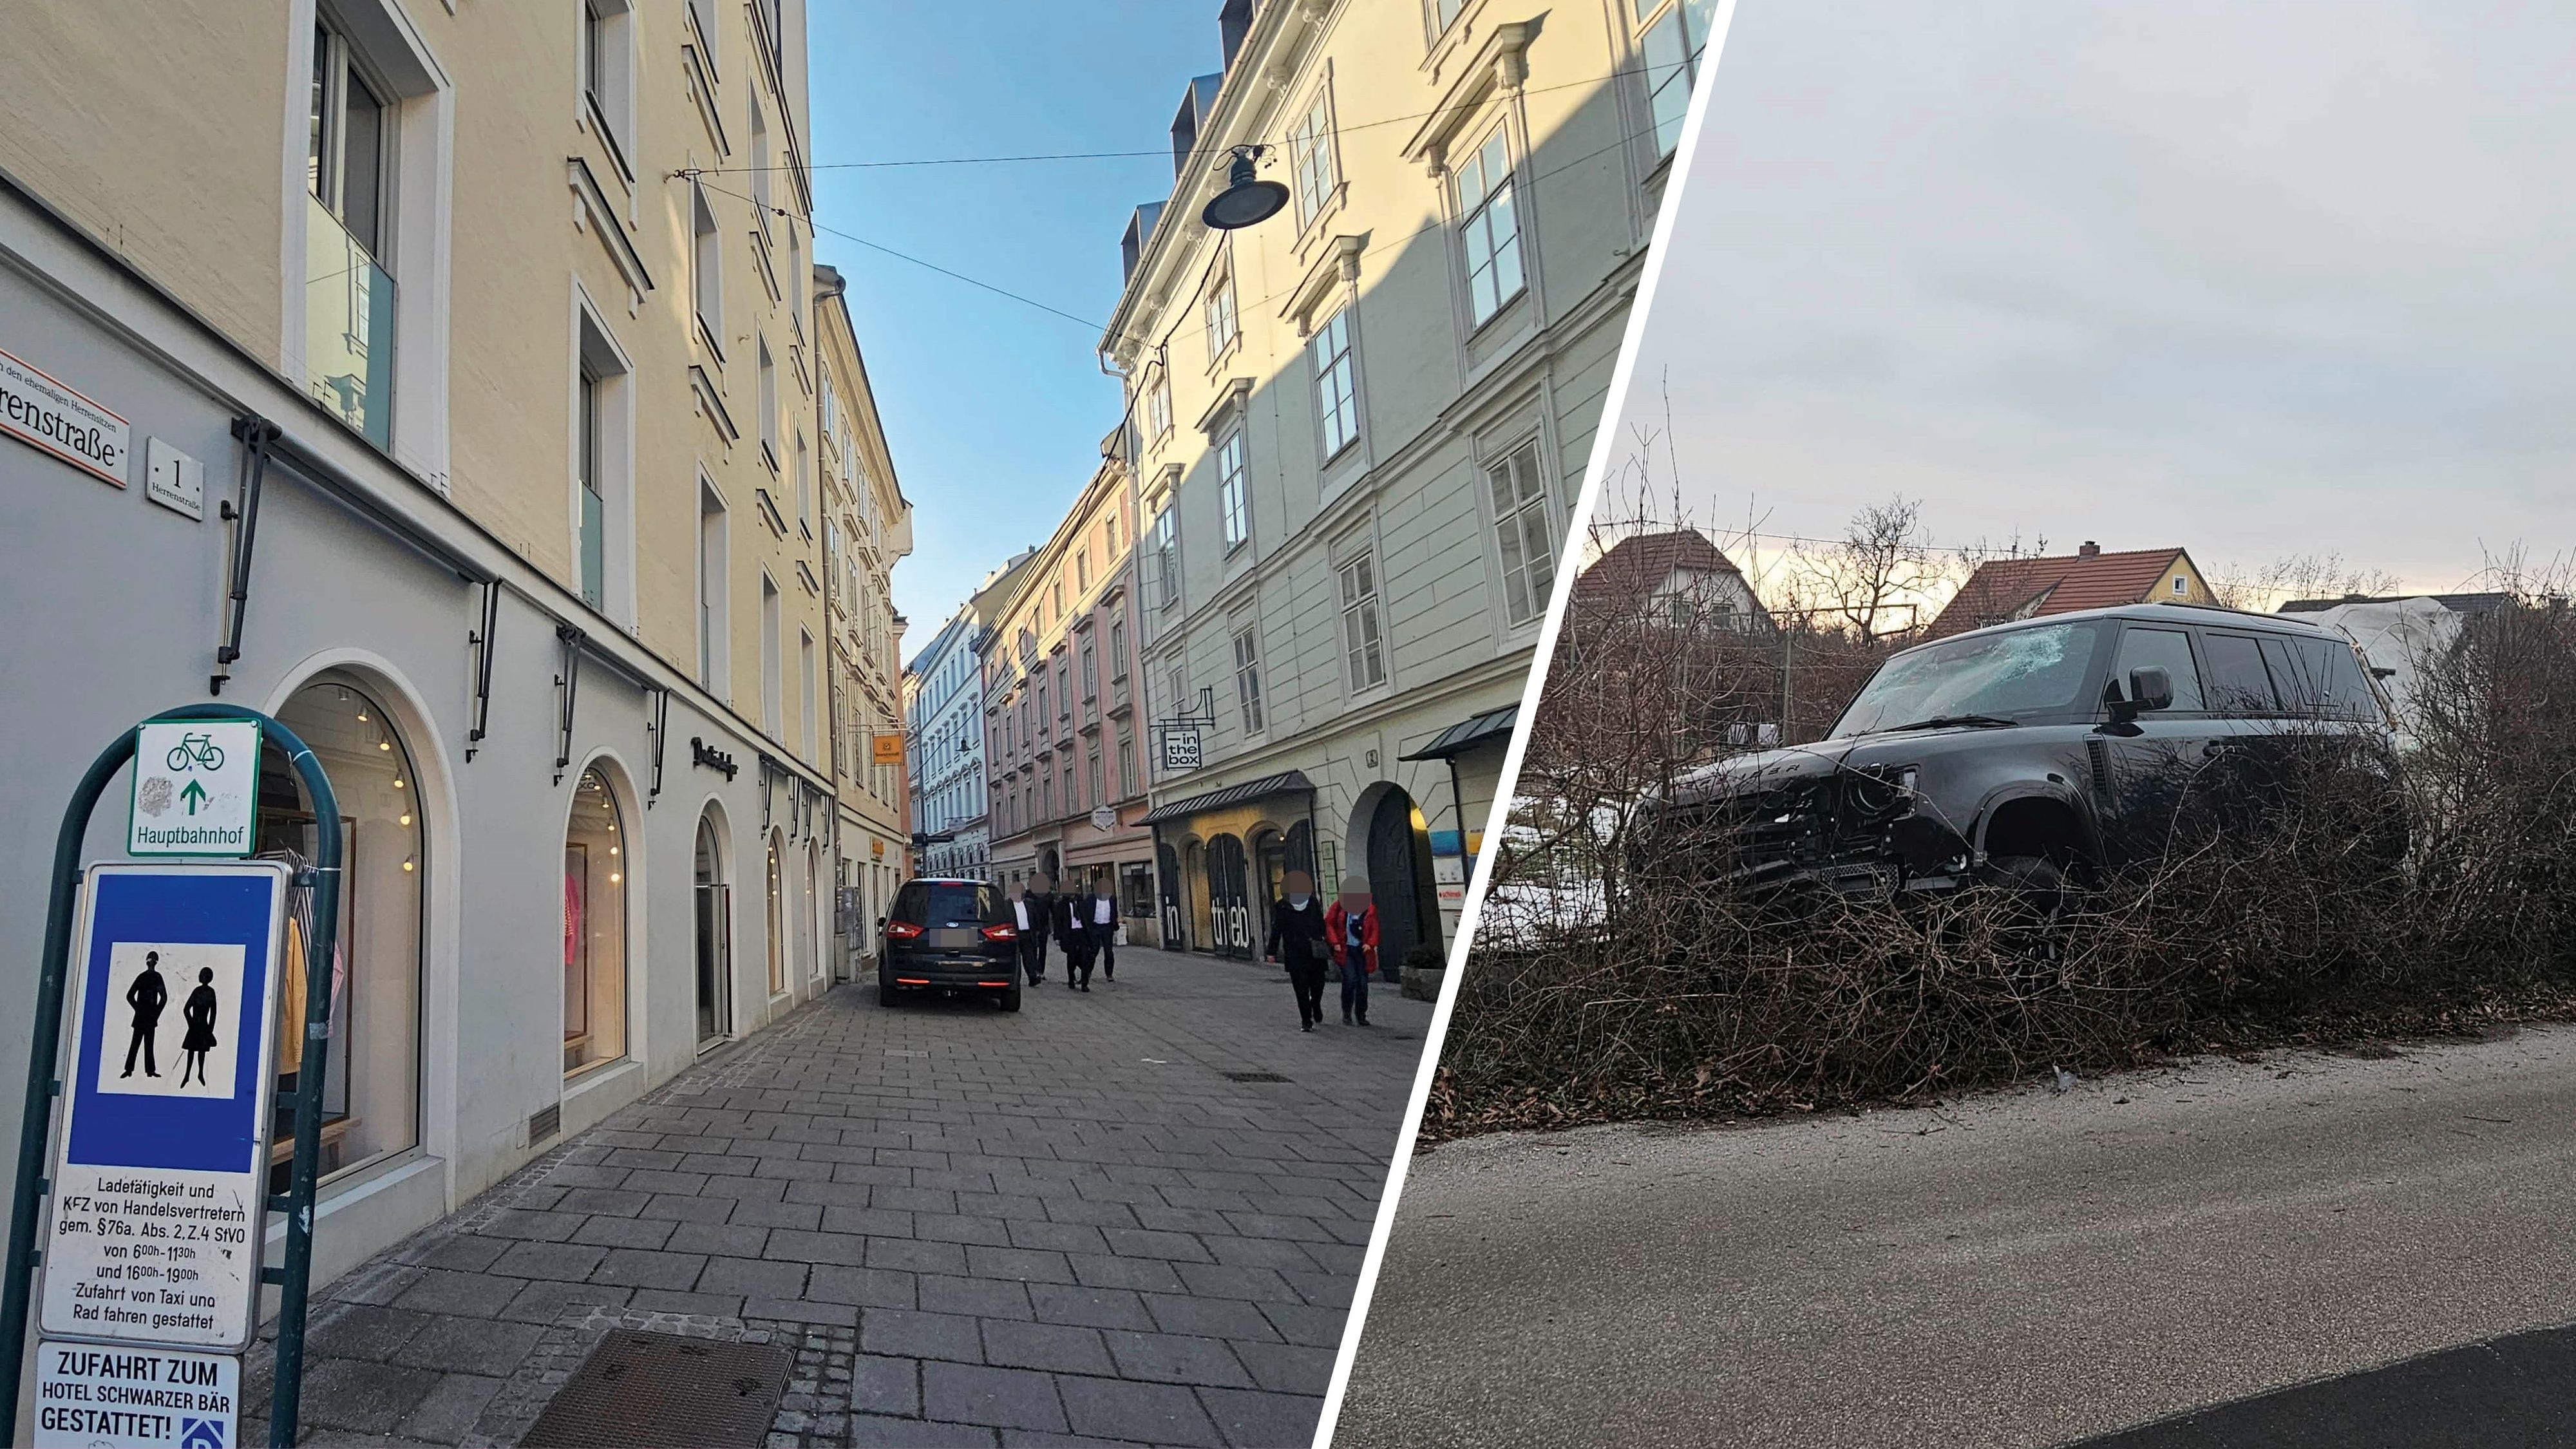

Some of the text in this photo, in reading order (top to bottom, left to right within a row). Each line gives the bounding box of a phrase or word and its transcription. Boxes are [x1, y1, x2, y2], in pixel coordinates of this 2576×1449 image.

[6, 366, 22, 381] den
[24, 377, 69, 406] ehemaligen
[71, 400, 117, 433] Herrensitzen
[173, 459, 181, 488] 1
[152, 482, 201, 511] Herrenstraße
[1168, 744, 1197, 754] the
[1182, 733, 1197, 744] in
[1169, 755, 1198, 764] box
[137, 826, 244, 848] Hauptbahnhof
[1166, 896, 1180, 940] in
[98, 1177, 214, 1198] Ladetätigkeit und
[63, 1196, 245, 1222] KFZ von Handelsvertretern
[59, 1220, 91, 1235] gem.
[141, 1222, 169, 1238] Abs.
[214, 1227, 245, 1243] StVO
[104, 1245, 128, 1258] von
[97, 1264, 122, 1279] und
[75, 1283, 126, 1301] Zufahrt
[131, 1291, 155, 1303] von
[160, 1289, 184, 1305] Taxi
[73, 1303, 213, 1329] Rad fahren gestattet
[57, 1351, 218, 1387] ZUFAHRT ZUM
[43, 1381, 230, 1413] HOTEL SCHWARZER BÄR
[41, 1406, 171, 1439] GESTATTET!
